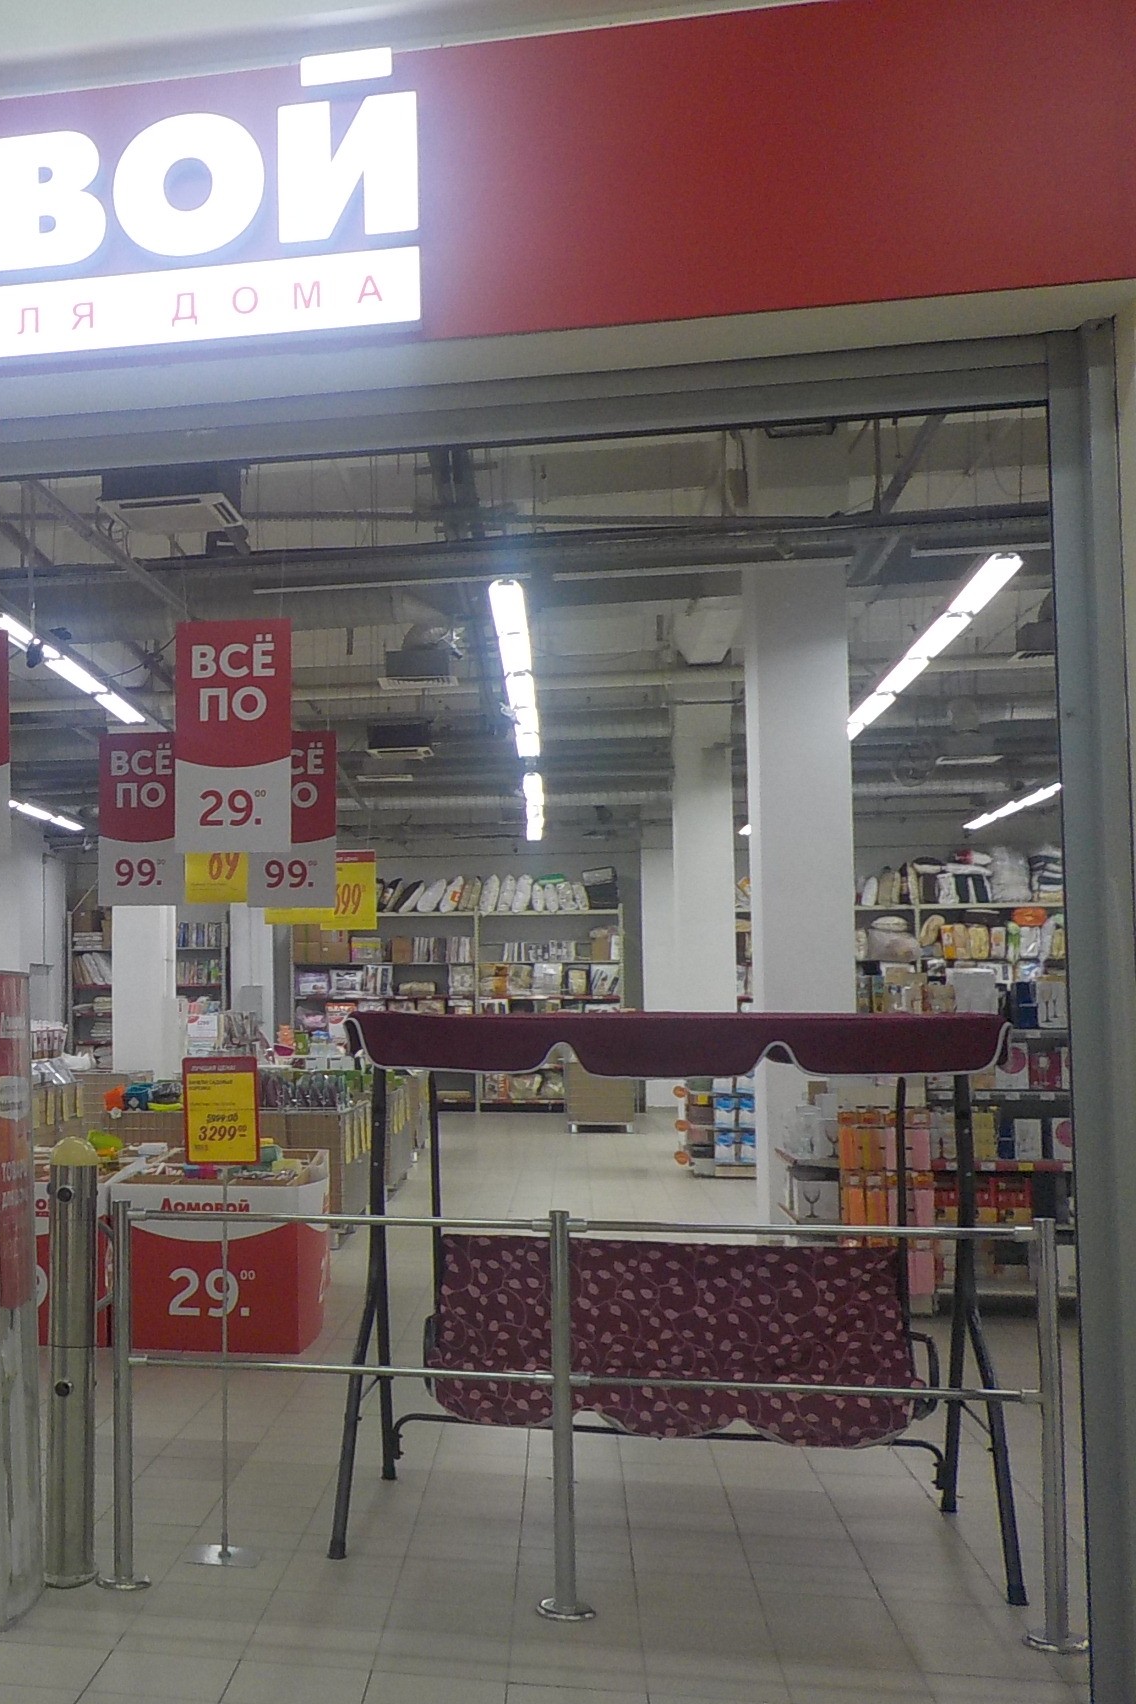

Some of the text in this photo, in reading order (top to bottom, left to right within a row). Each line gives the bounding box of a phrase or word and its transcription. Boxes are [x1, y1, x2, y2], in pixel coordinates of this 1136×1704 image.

[171, 275, 383, 326] ДОМА
[191, 633, 275, 679] ВСЁ
[198, 686, 268, 722] ПО
[110, 742, 173, 776] ВСЁ
[291, 741, 325, 775] СЁ
[116, 781, 167, 808] ПО
